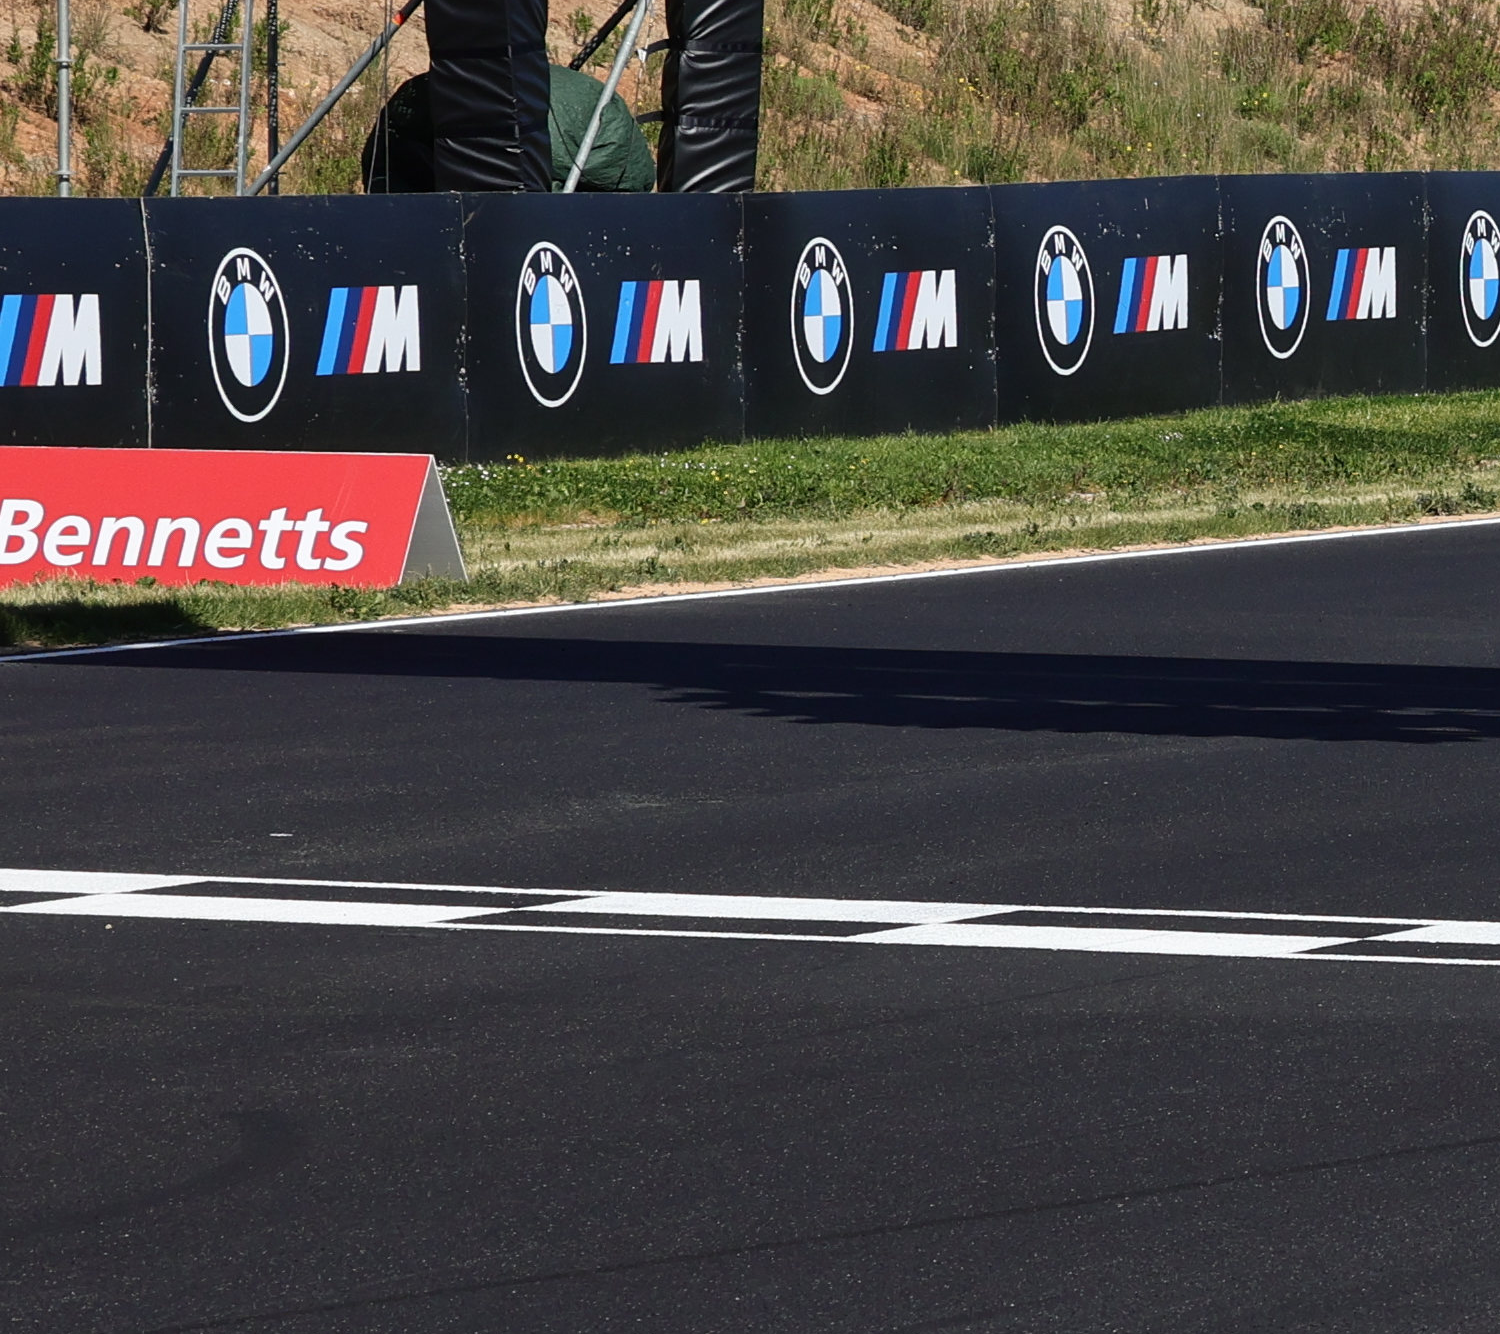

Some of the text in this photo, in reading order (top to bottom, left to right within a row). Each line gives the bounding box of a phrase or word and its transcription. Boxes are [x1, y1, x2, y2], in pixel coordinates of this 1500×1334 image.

[1040, 233, 1189, 332] BMW M
[1262, 223, 1397, 320] BMW M
[1465, 218, 1500, 256] BMW
[37, 293, 102, 387] M
[216, 257, 421, 374] BMW M
[523, 250, 704, 364] BMW M
[799, 245, 958, 350] BMW M
[0, 498, 369, 572] Bennetts
